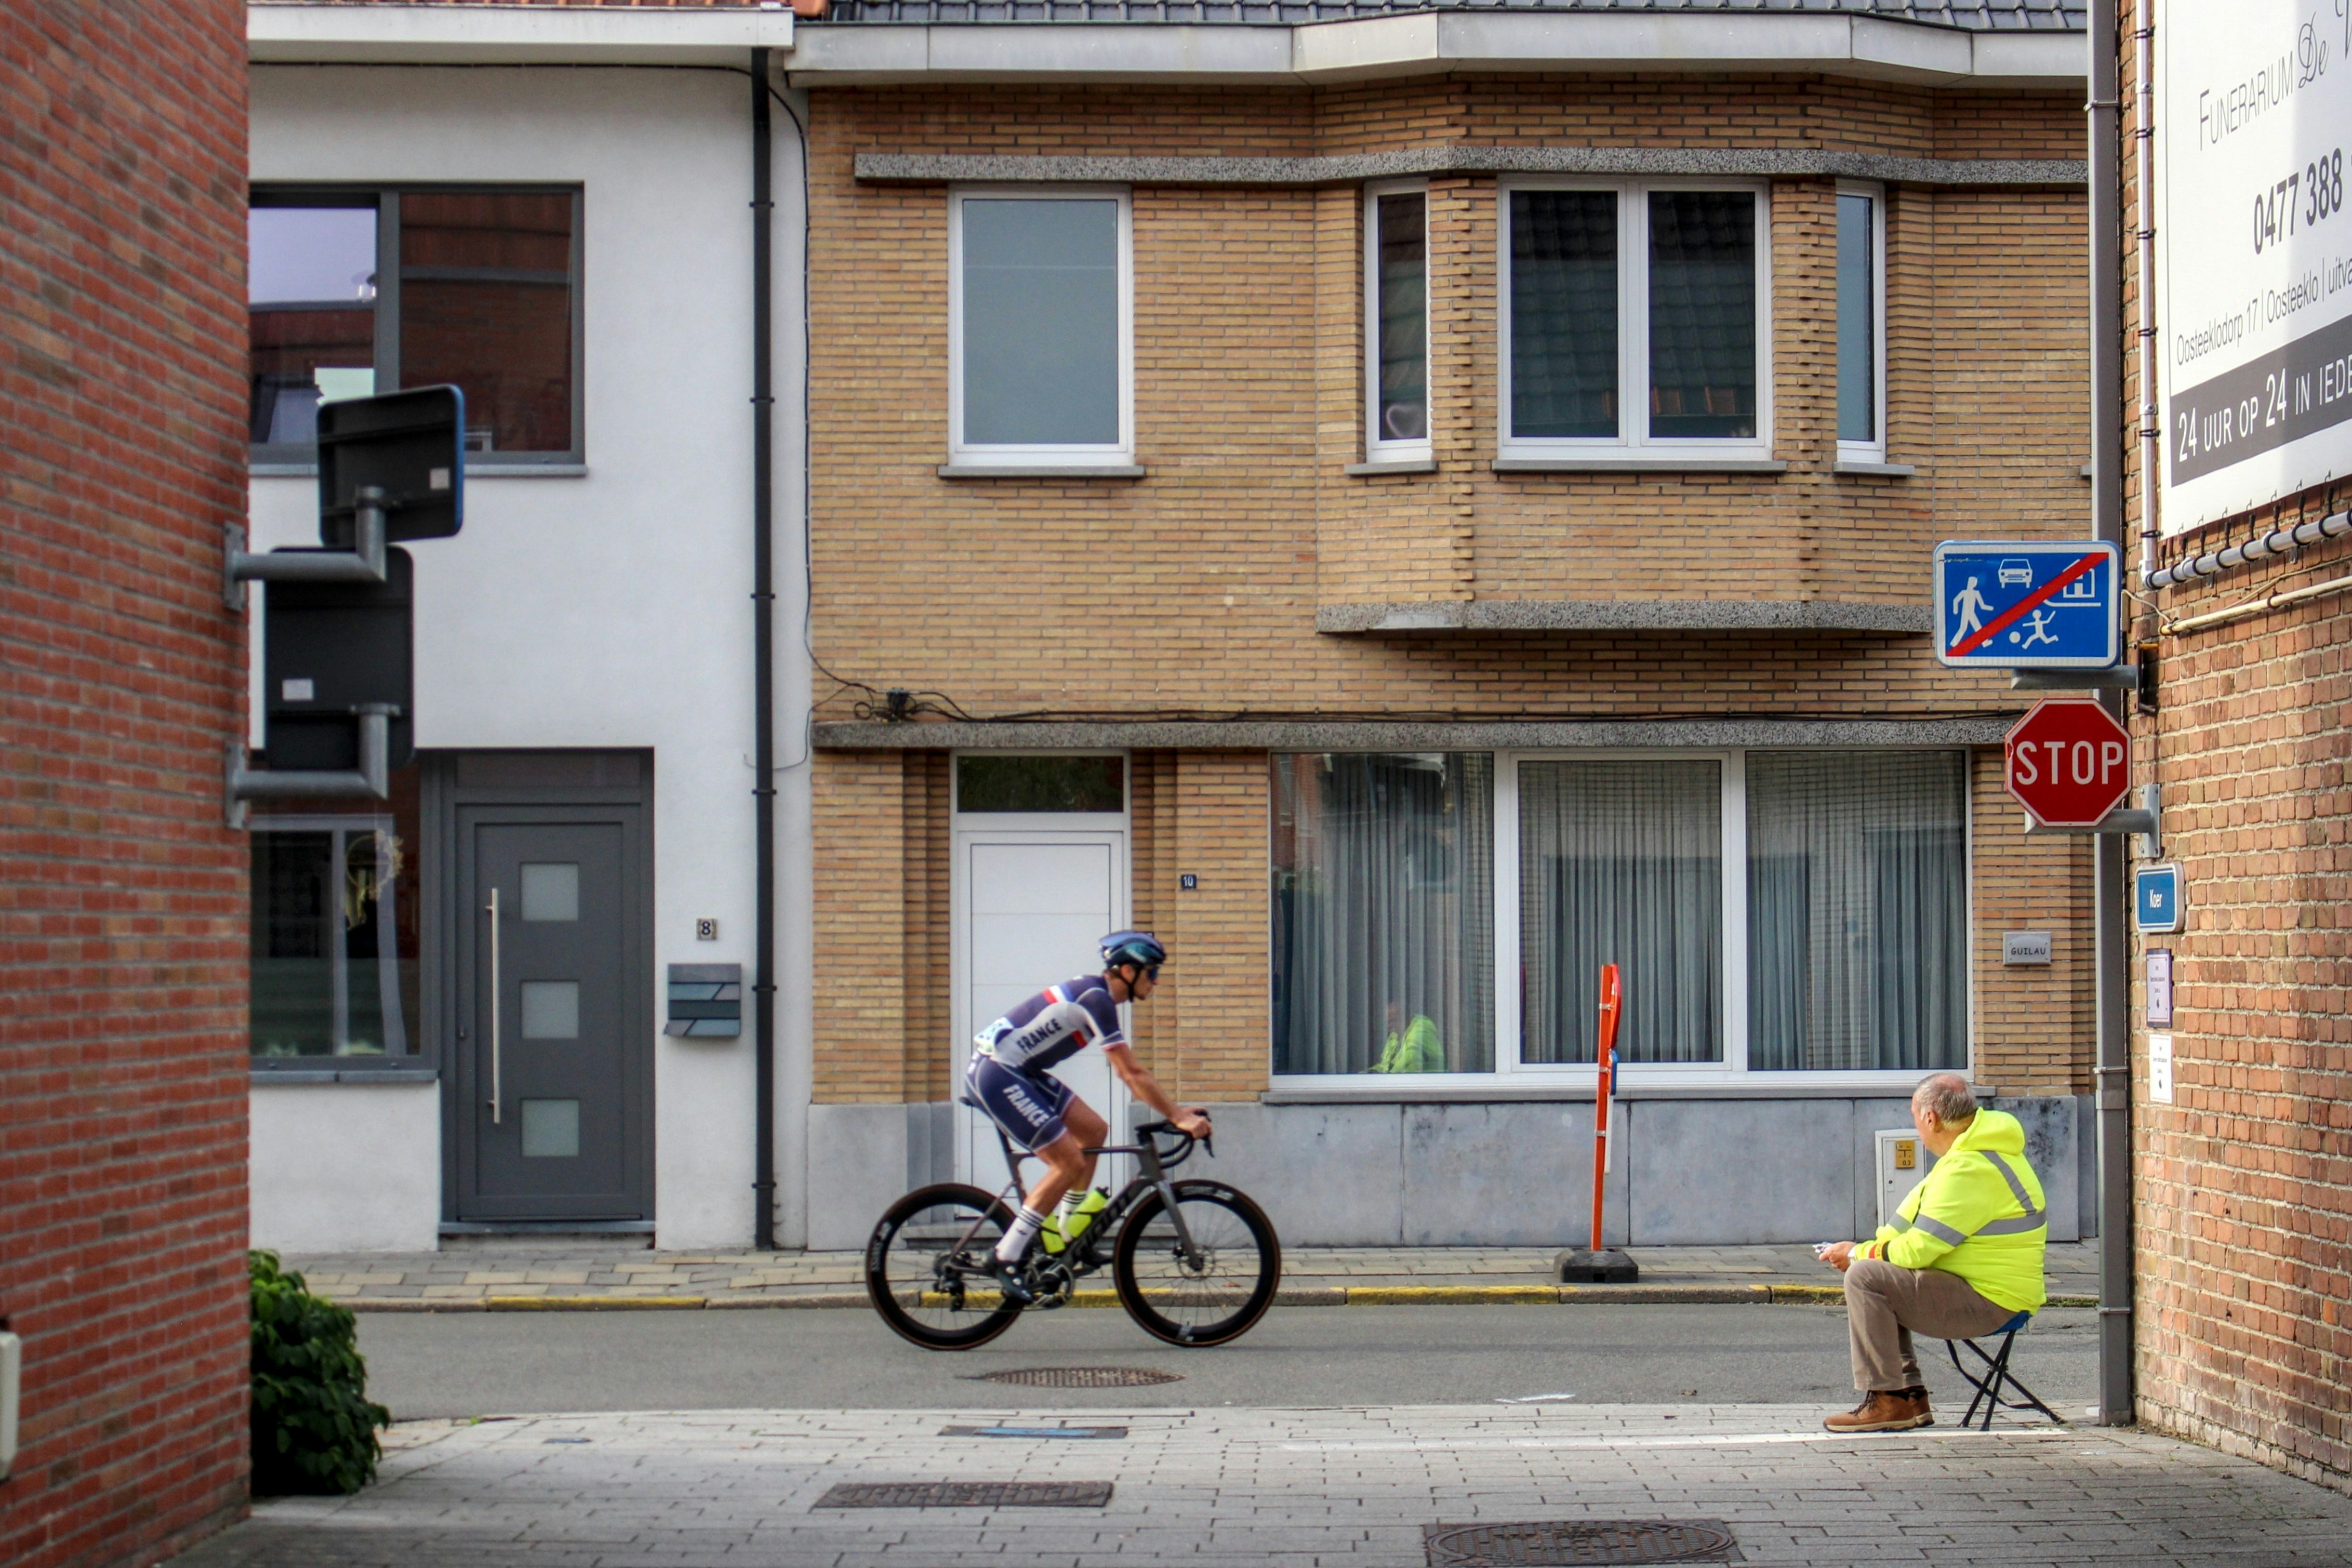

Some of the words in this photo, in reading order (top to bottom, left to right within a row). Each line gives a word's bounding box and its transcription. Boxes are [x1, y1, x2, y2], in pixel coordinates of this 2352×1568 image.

[2200, 50, 2293, 151] FUNERARIUM
[2298, 11, 2330, 89] De
[2254, 171, 2299, 255] 0477
[2306, 148, 2342, 227] 388
[2177, 312, 2243, 366] Oosteeklodorp
[2247, 297, 2258, 334] 17
[2267, 270, 2318, 324] Oosteeklo
[2179, 407, 2197, 462] 24
[2204, 408, 2232, 451] UUR
[2239, 396, 2258, 437] OP
[2266, 368, 2287, 428] 24
[2295, 373, 2310, 415] IN
[2016, 740, 2123, 785] STOP
[1183, 875, 1193, 887] 10
[2149, 889, 2162, 908] Koer
[702, 921, 711, 935] 8
[1016, 1018, 1062, 1054] FRANCE
[1003, 1084, 1050, 1128] FRANCE
